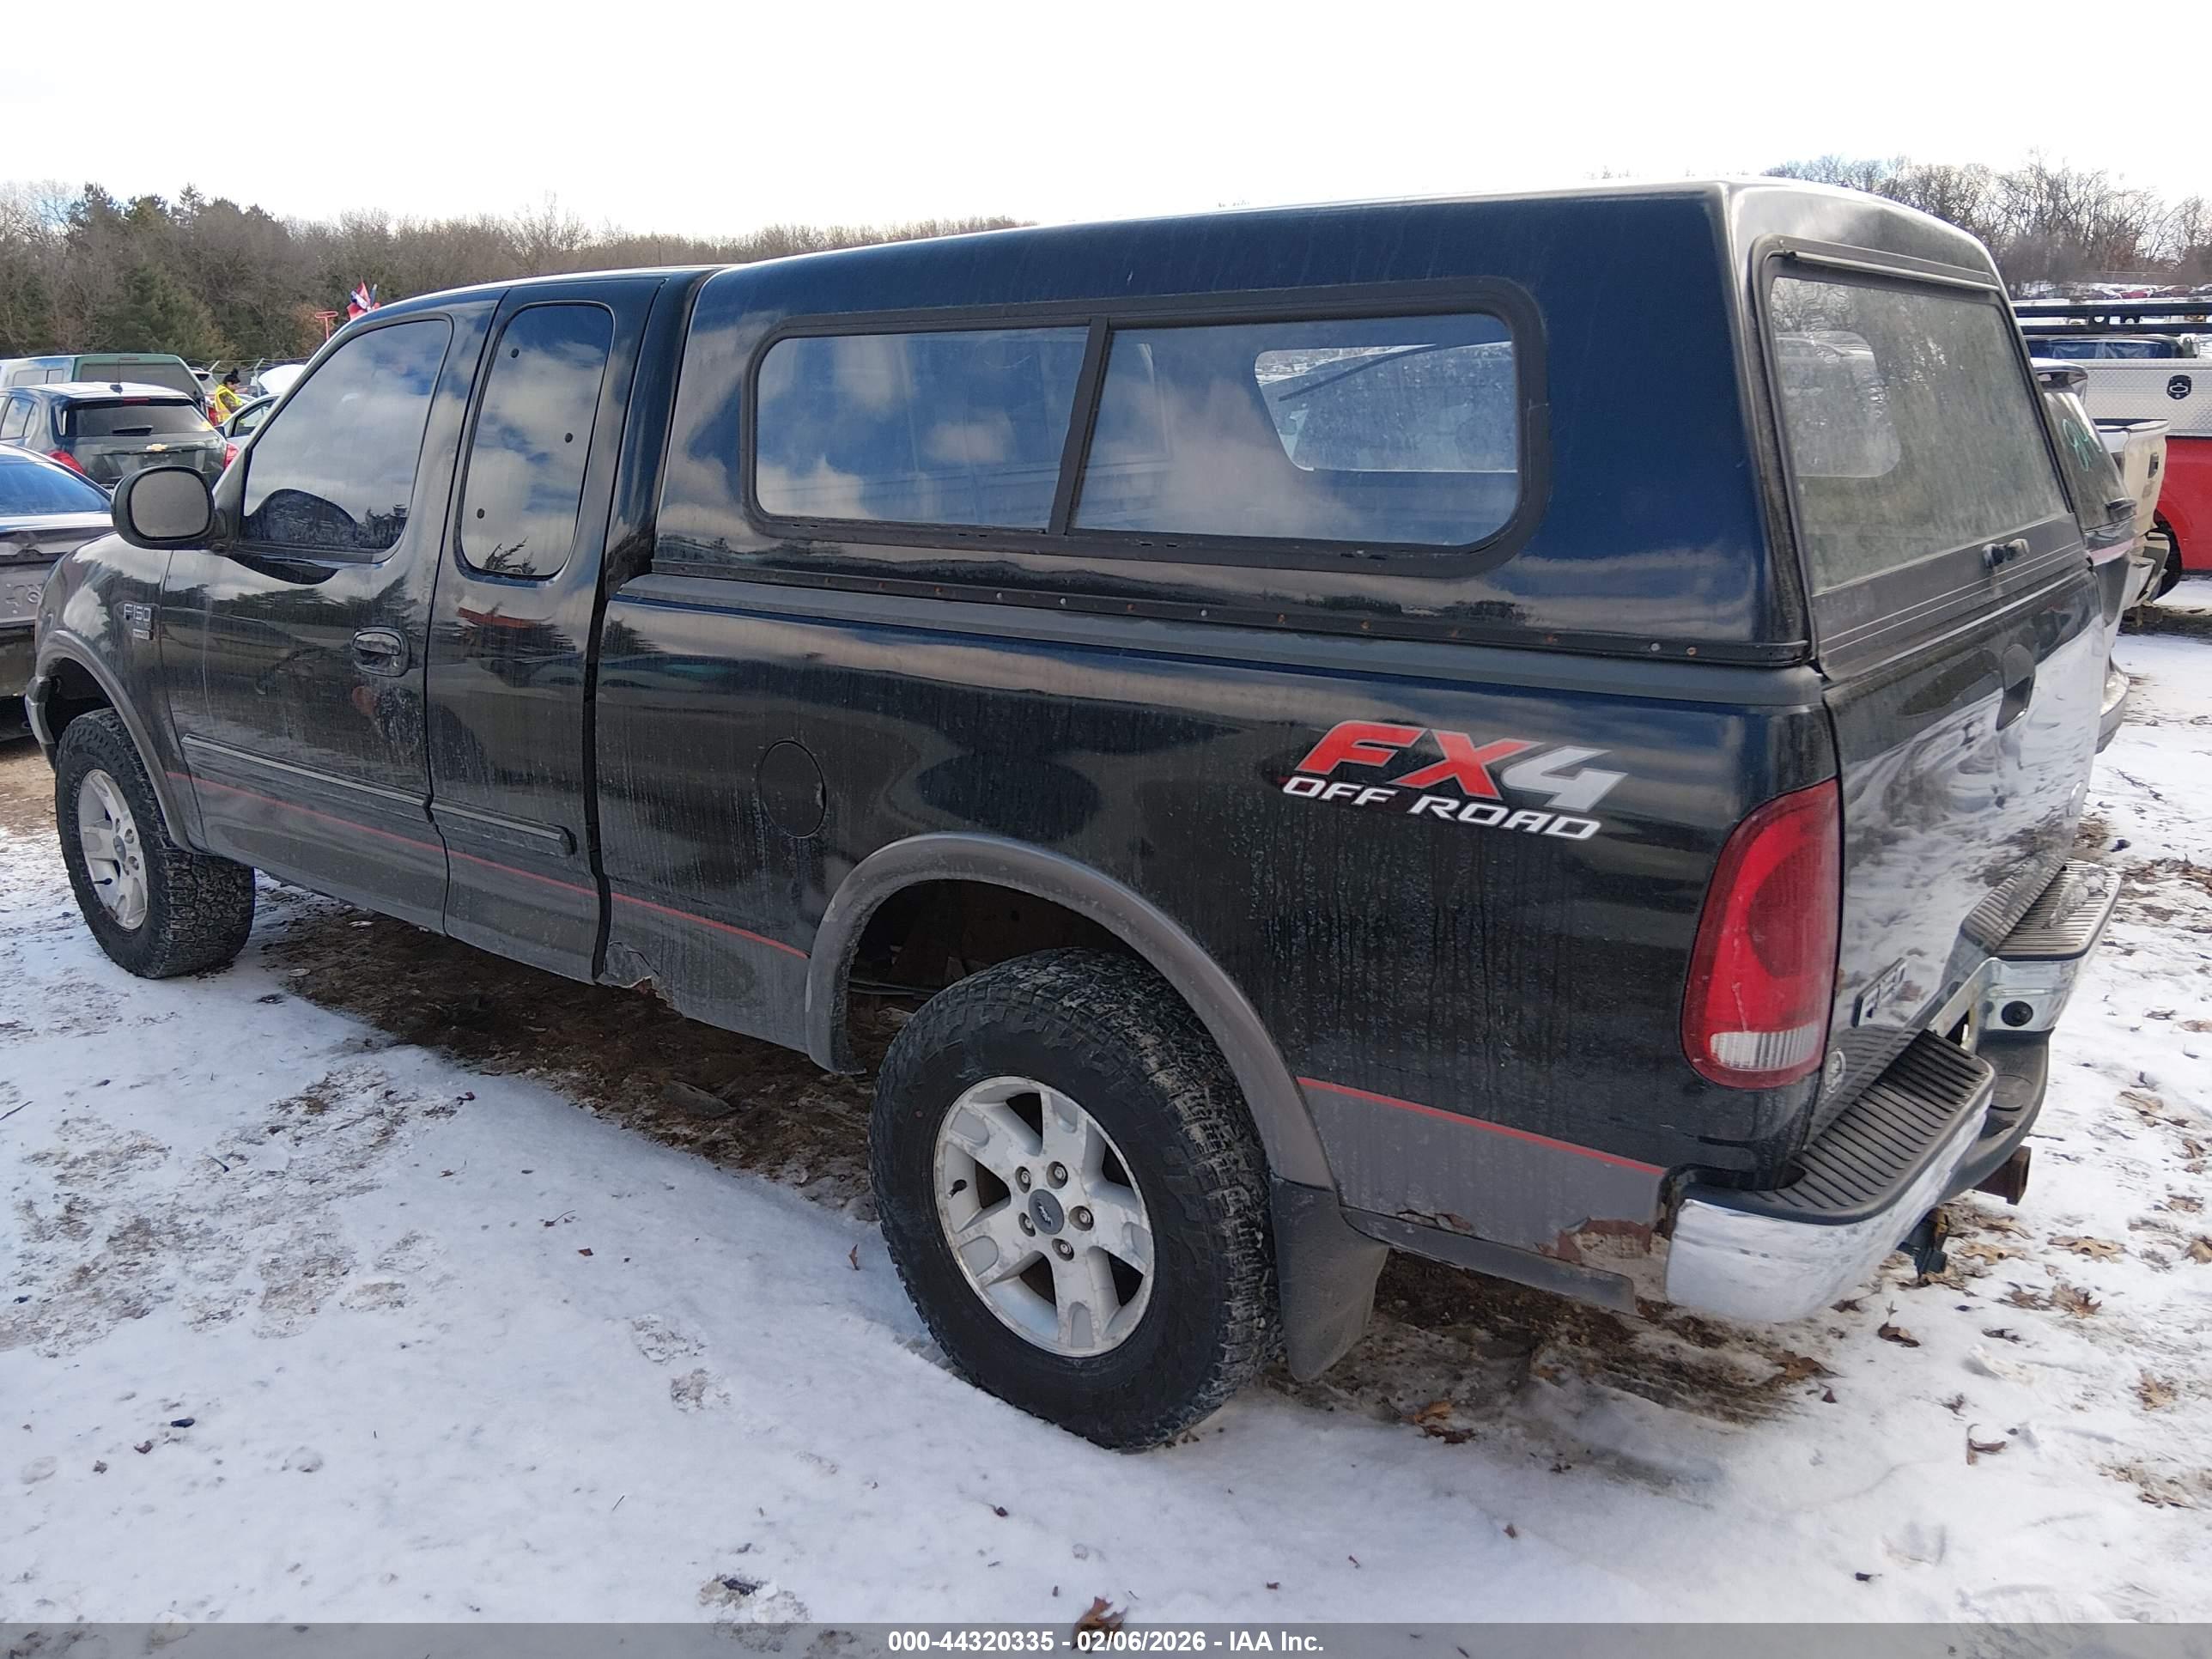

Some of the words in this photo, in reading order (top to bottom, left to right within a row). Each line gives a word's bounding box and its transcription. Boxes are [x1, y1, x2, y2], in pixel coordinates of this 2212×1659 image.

[1294, 720, 1628, 813] FX4
[1281, 775, 1400, 805] OFF
[1407, 794, 1601, 841] ROAD
